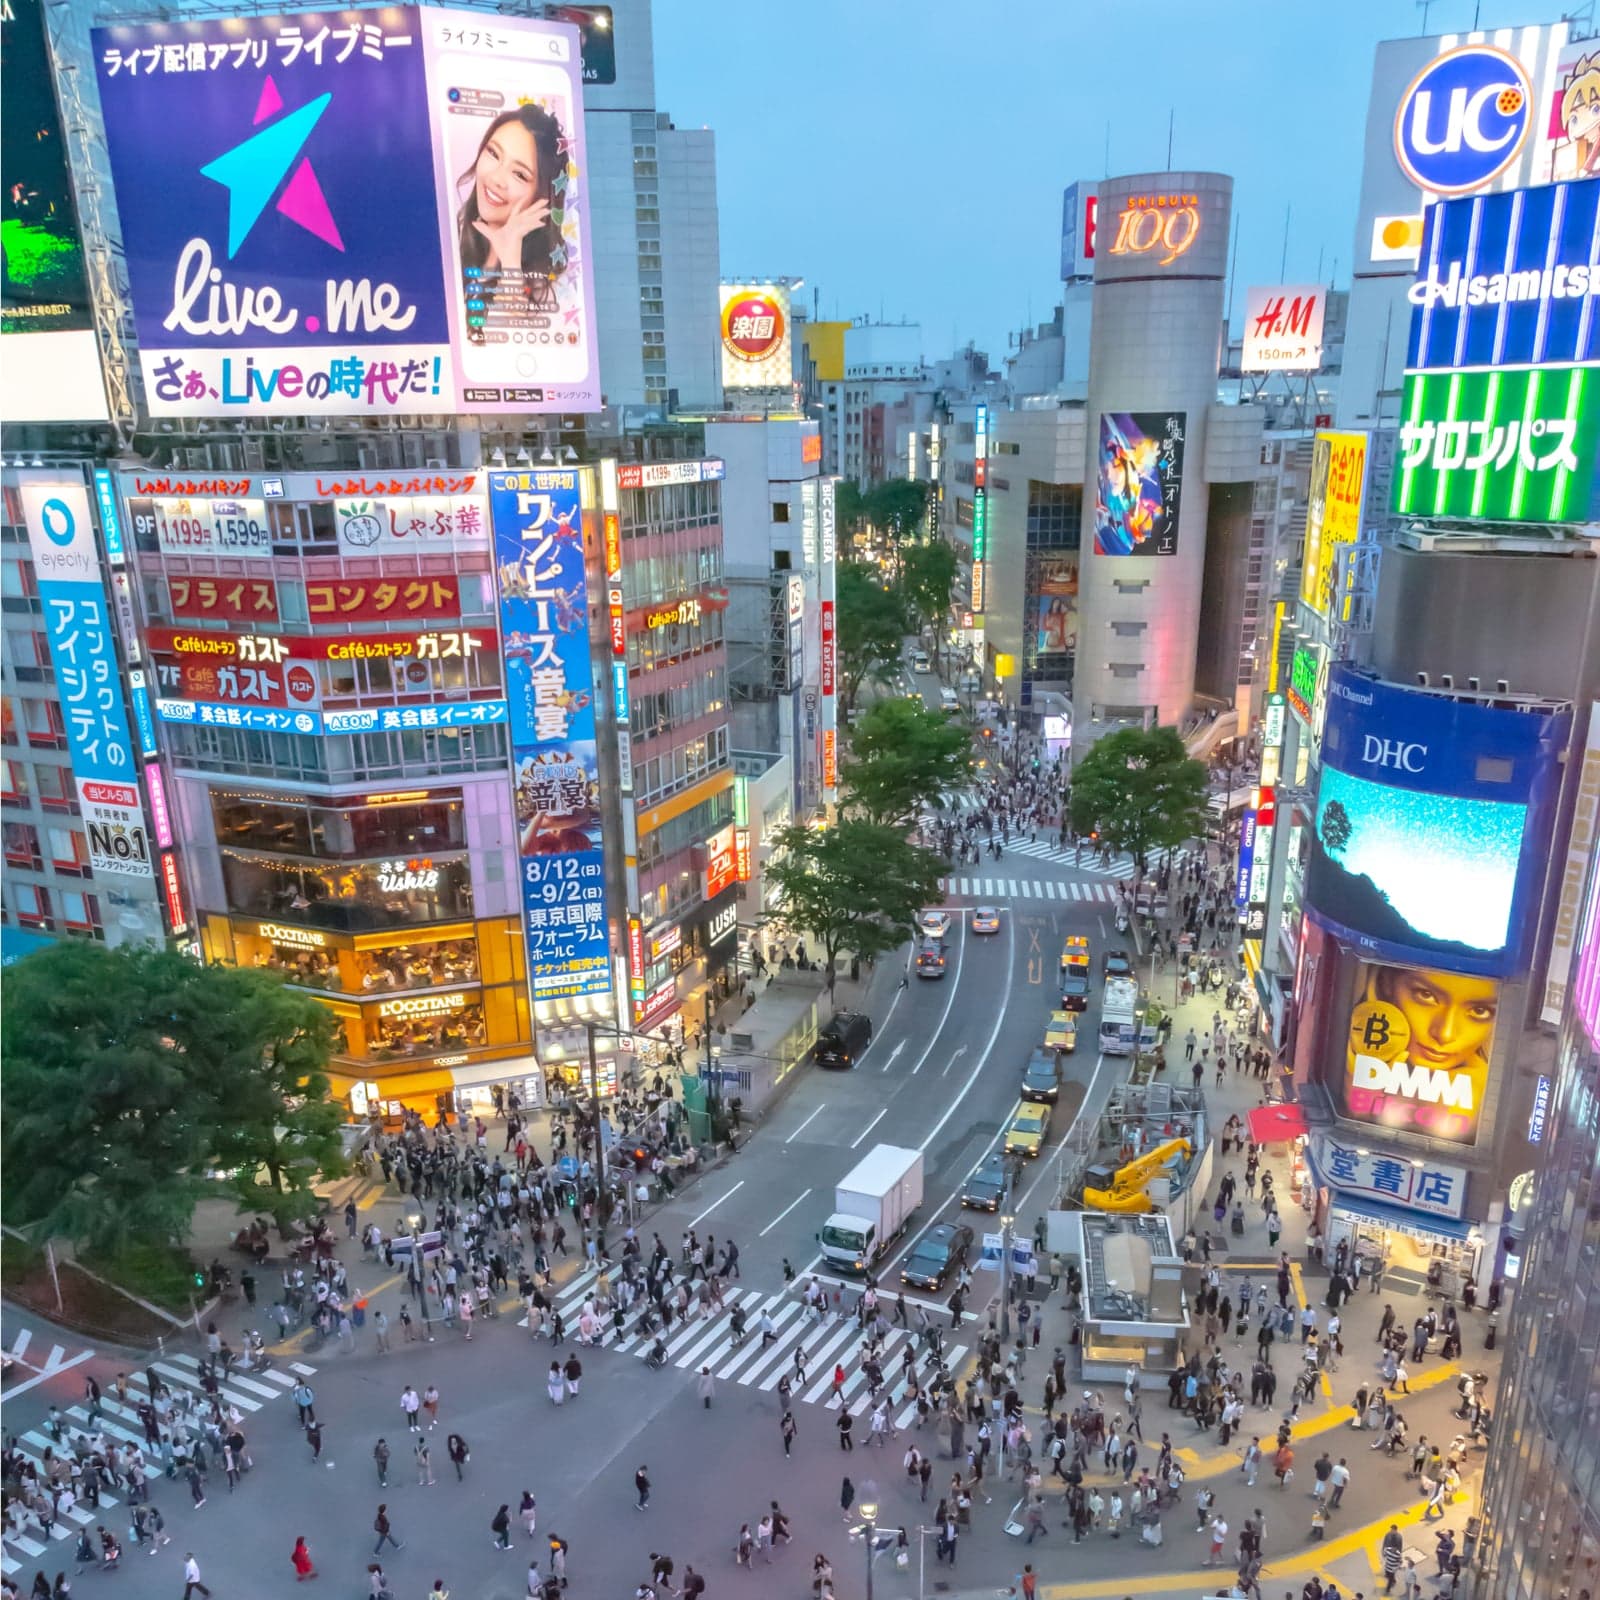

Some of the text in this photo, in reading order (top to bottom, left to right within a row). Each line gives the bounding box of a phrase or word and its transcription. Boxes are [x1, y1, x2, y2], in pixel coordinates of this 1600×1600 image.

[103, 24, 413, 76] ライブ配信アプリ ライブミー
[442, 28, 508, 48] ライブミー
[1411, 83, 1520, 154] UC
[1128, 195, 1198, 208] SHIBUYA
[1108, 206, 1199, 266] 109
[163, 237, 416, 335] live.me
[732, 315, 775, 339] 楽園
[1254, 295, 1316, 338] H&M
[1258, 349, 1293, 360] 150m
[1400, 418, 1577, 472] サロンパス
[135, 477, 250, 496] しゃぶしゃぶバイキング
[316, 476, 476, 496] しゃぶしゃぶバイキング
[135, 515, 154, 534] 9F
[390, 504, 482, 537] しゃぶ葉
[822, 484, 831, 564] BIC CAMERA
[42, 551, 90, 571] eyecity
[170, 581, 275, 611] プライス
[308, 580, 454, 613] コンタクト
[678, 600, 701, 624] ガスト
[173, 635, 289, 663] Caféレストラン ガスト
[327, 632, 482, 661] Caféレストラン ガスト
[50, 600, 99, 764] アイシティ
[80, 601, 125, 766] コンタクトの
[158, 665, 181, 686] 7F
[187, 665, 215, 682] Café
[217, 666, 280, 701] ガスト
[292, 681, 313, 693] ガスト
[1343, 687, 1373, 706] Channel
[162, 703, 193, 719] AEON
[200, 705, 291, 730] 英会話イーオン
[331, 705, 504, 730] AEON 英会話イーオン
[1362, 735, 1427, 773] DHC
[86, 820, 149, 863] No.1
[530, 903, 602, 928] 東京国際
[709, 903, 737, 938] LUSH
[259, 924, 326, 947] L'OCCITANE
[531, 923, 604, 948] フォーラム
[1360, 936, 1378, 948] DHC
[532, 945, 575, 961] ホールC
[380, 994, 465, 1017] L'OCCITANE
[1353, 1054, 1473, 1109] DMM
[1350, 1089, 1472, 1134] Bicon
[1327, 1150, 1454, 1205] 堂書店
